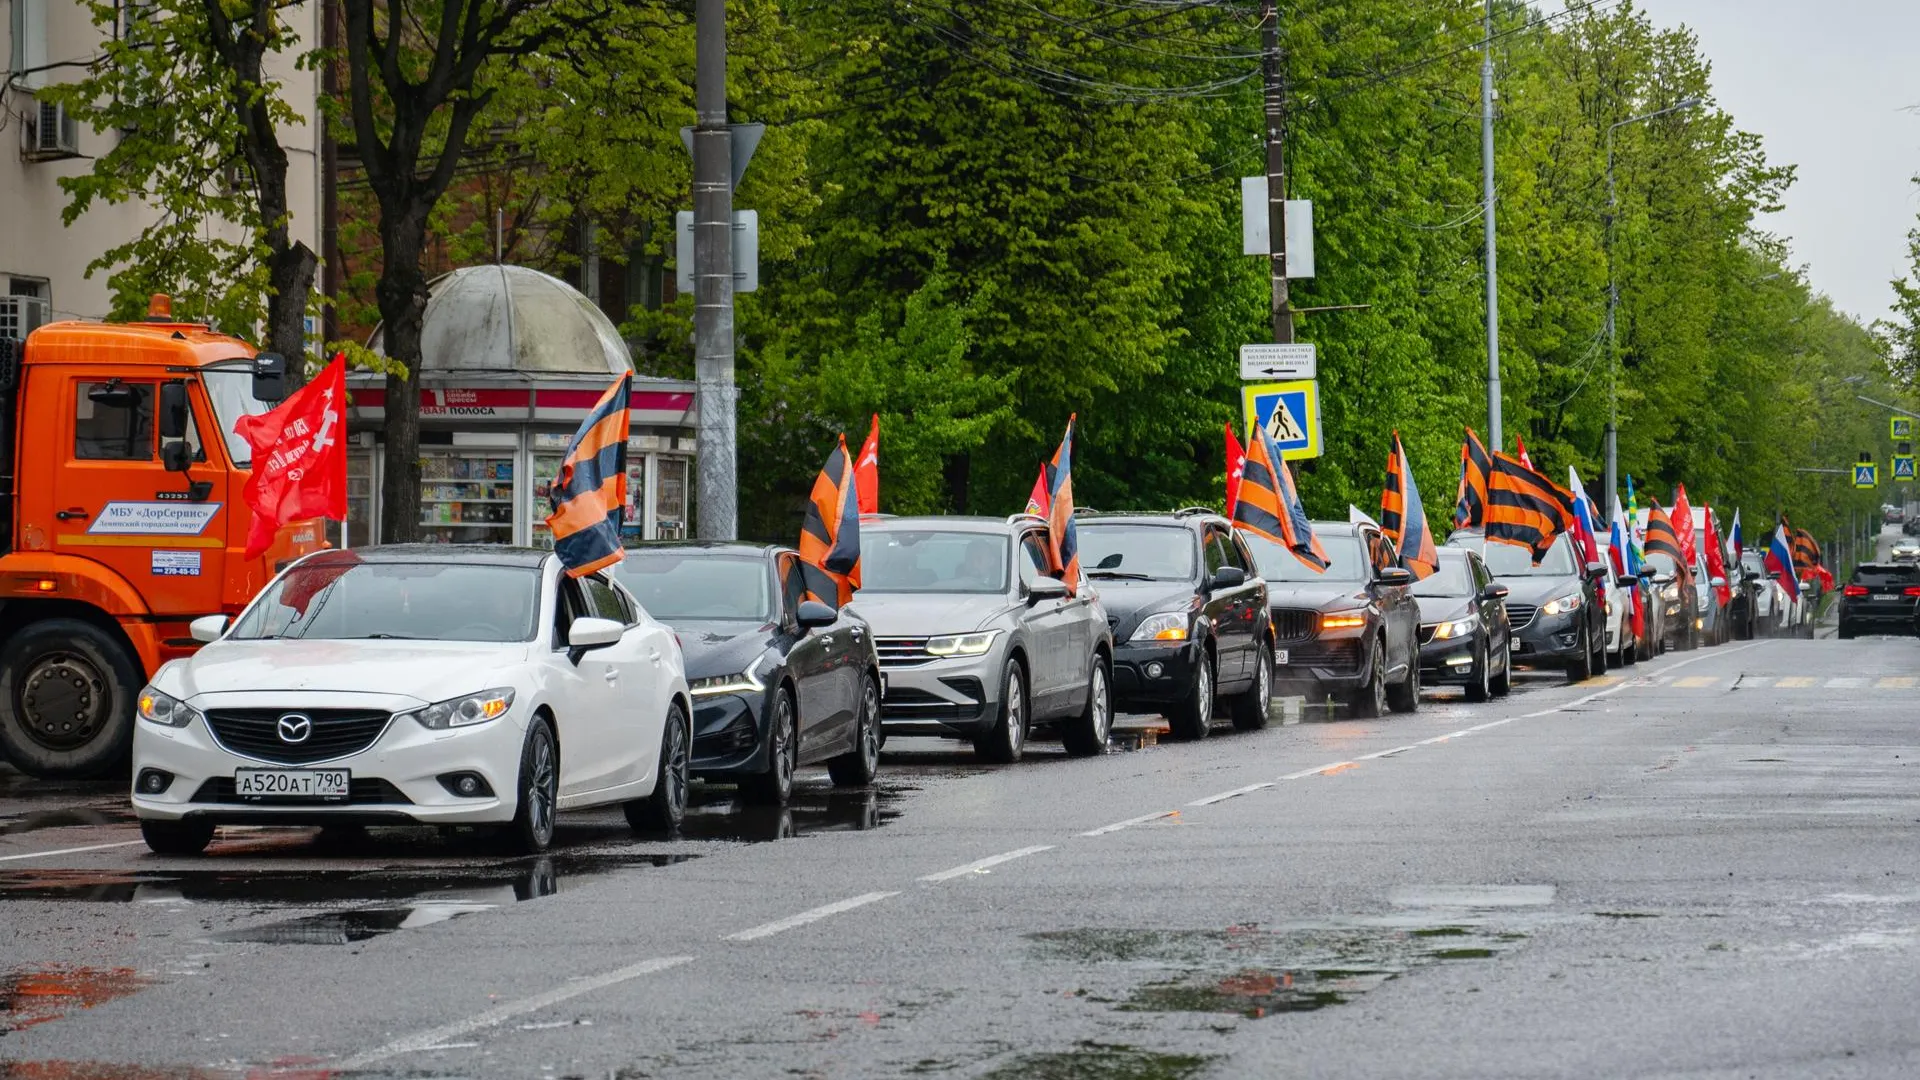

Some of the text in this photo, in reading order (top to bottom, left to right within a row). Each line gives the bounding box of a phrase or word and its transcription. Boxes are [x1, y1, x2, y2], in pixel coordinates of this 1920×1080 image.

[450, 407, 496, 415] ПОЛОСА
[110, 508, 208, 519] МБУ «ДорСервис»
[99, 520, 139, 528] Ленинский
[141, 521, 179, 529] городской
[316, 773, 342, 787] 790
